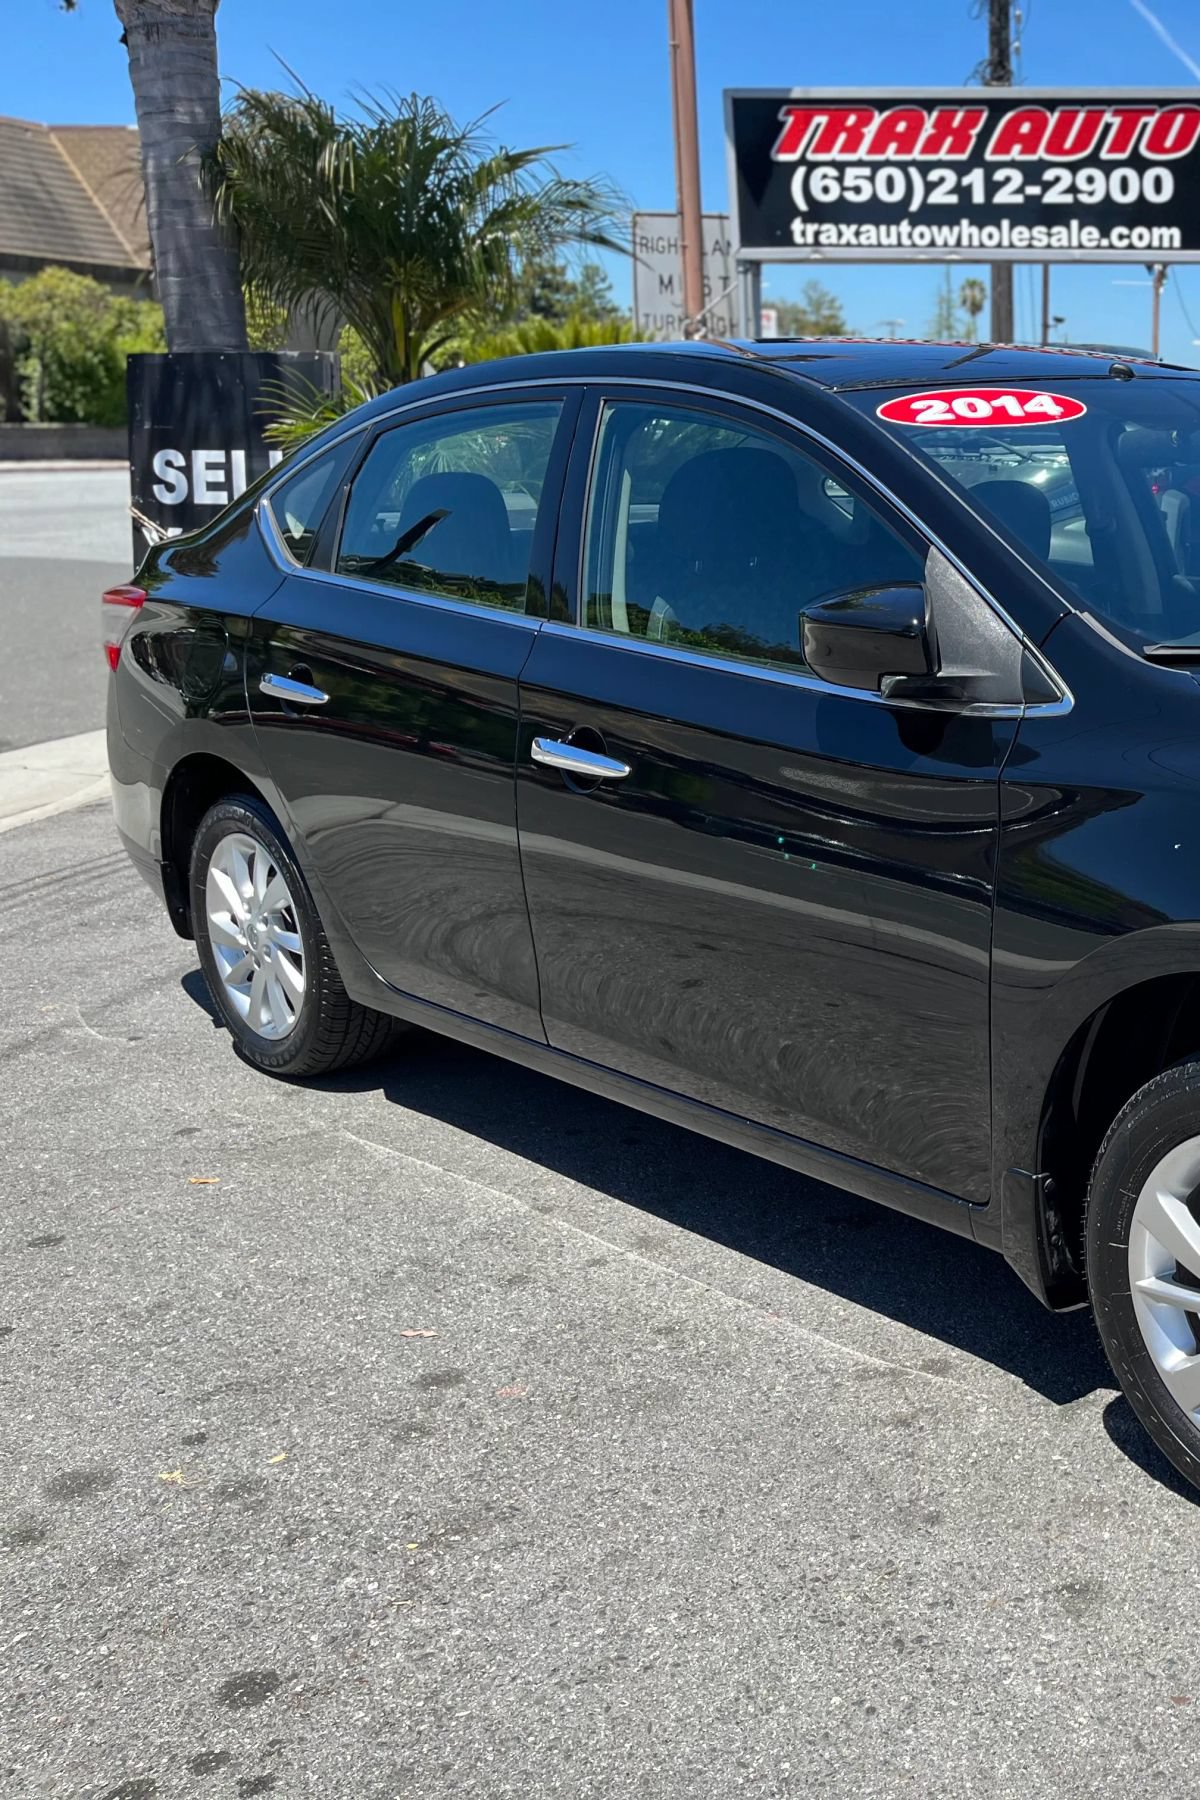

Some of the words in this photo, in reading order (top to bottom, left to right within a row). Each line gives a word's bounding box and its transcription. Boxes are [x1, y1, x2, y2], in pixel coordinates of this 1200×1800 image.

[771, 105, 988, 161] TRAX
[791, 166, 1174, 212] (650)212-2900
[640, 236, 680, 255] RIGH
[790, 217, 1181, 248] traxautowholesale.com
[658, 273, 731, 297] MST
[910, 395, 1064, 422] 2014
